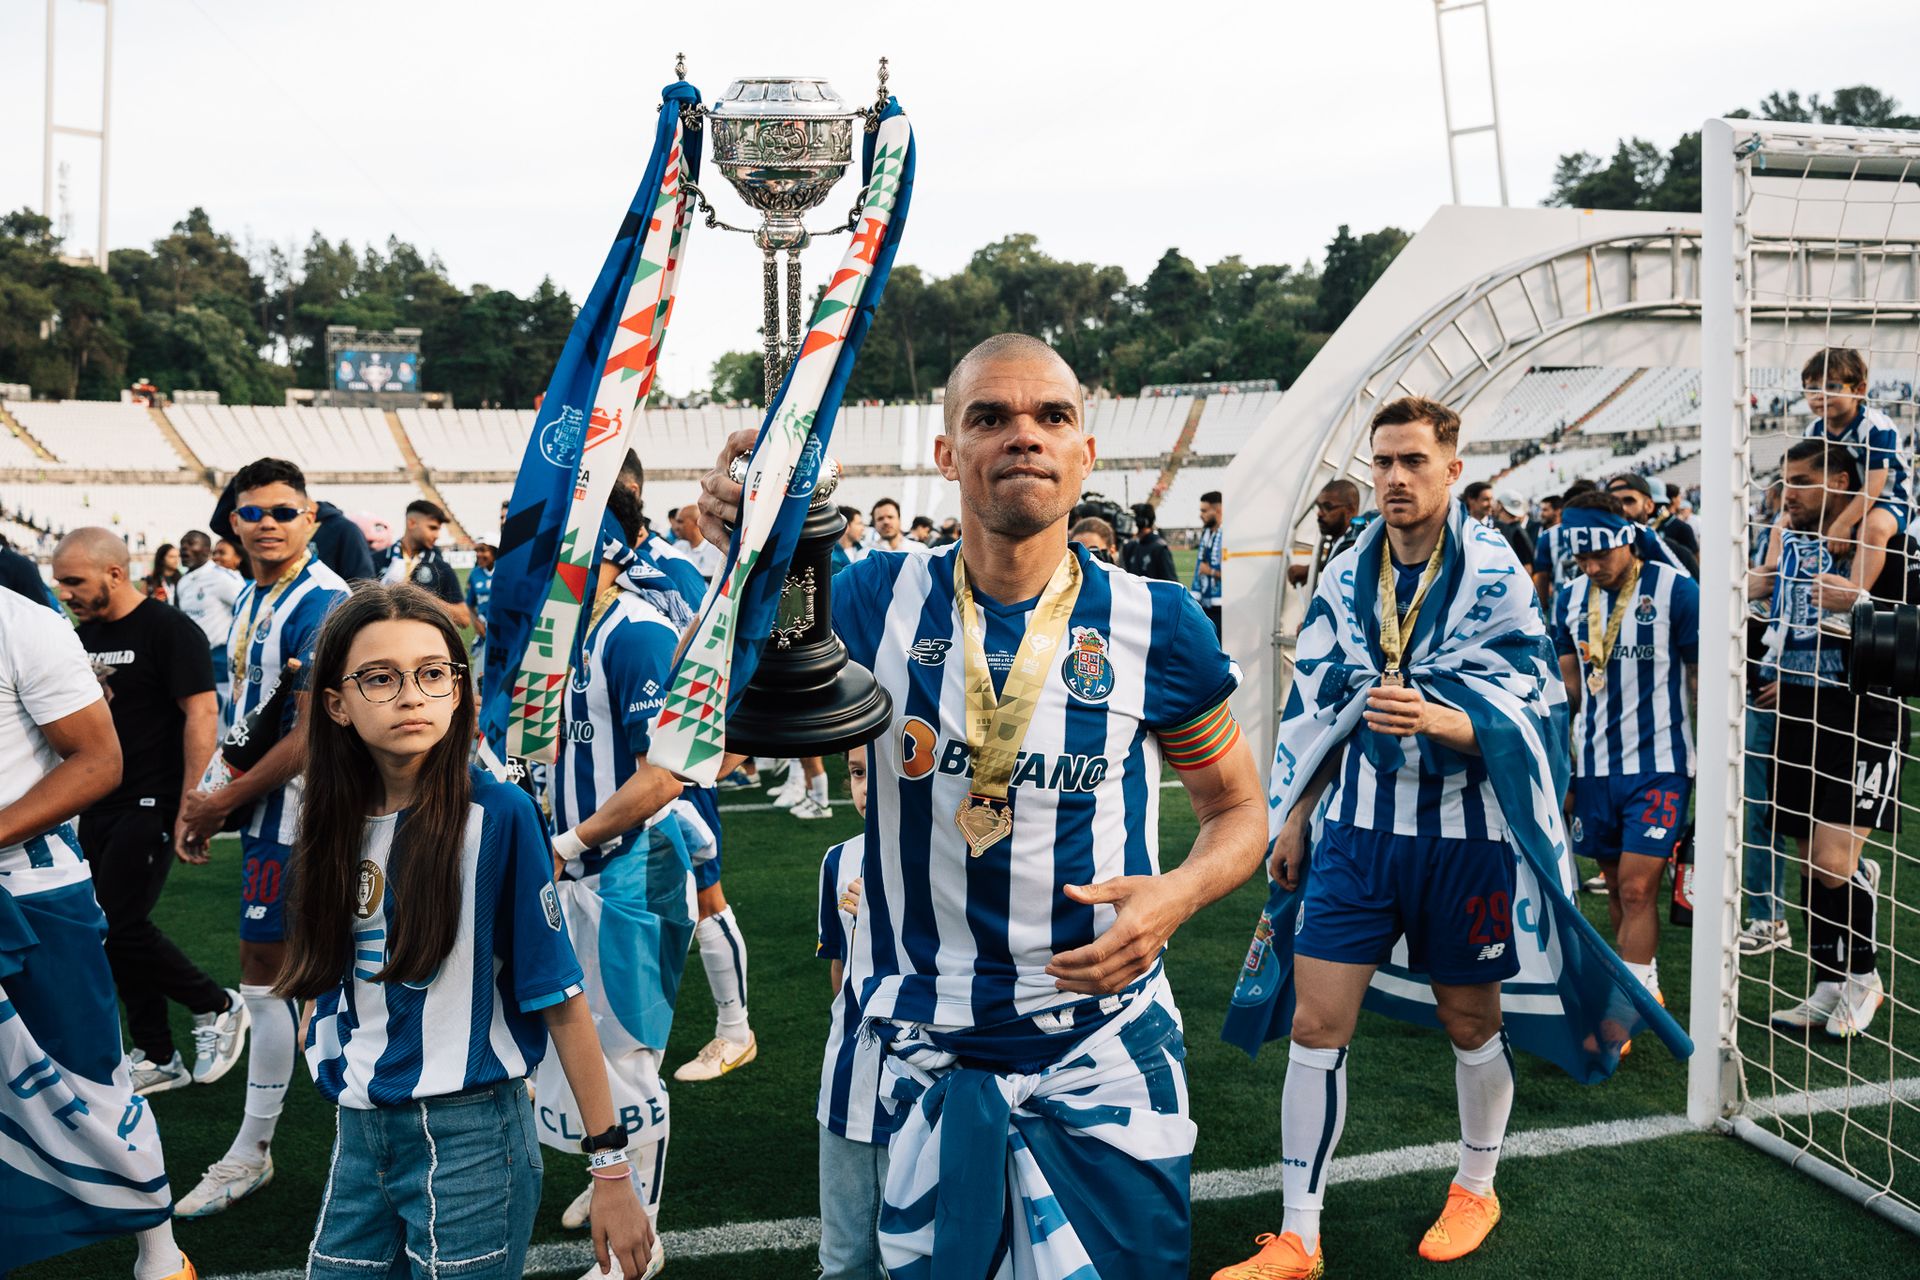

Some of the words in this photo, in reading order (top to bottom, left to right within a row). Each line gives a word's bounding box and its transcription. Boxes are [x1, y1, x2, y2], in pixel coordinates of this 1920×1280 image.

[629, 697, 667, 712] BINAN
[1856, 761, 1883, 799] 14
[1641, 788, 1680, 828] 25
[243, 857, 281, 904] 30
[1466, 890, 1512, 945] 29
[540, 1096, 665, 1140] CLBE
